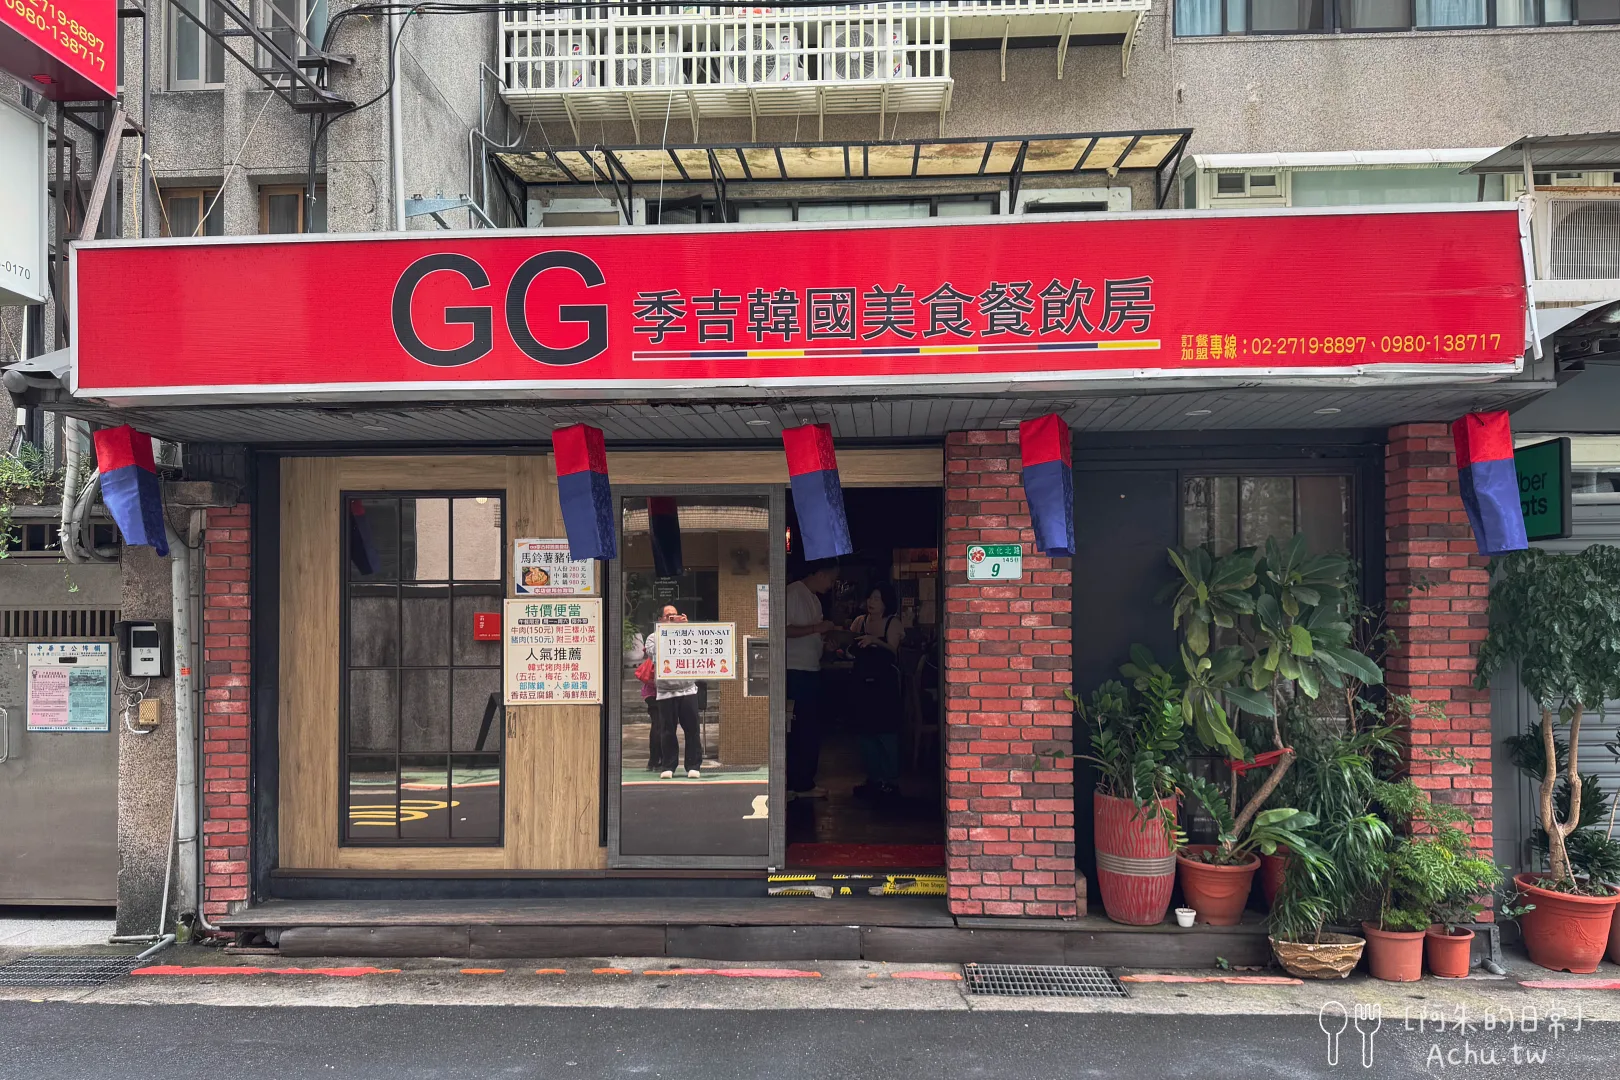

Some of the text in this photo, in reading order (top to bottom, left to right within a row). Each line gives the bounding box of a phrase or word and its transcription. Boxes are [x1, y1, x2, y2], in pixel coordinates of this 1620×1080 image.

[392, 251, 1155, 367] GG 季吉韓國美食餐飲房
[1520, 495, 1548, 516] ats
[991, 563, 1000, 577] 9
[525, 604, 581, 617] 特價便當
[525, 647, 581, 661] 人氣推薦
[676, 658, 716, 668] 週日公休
